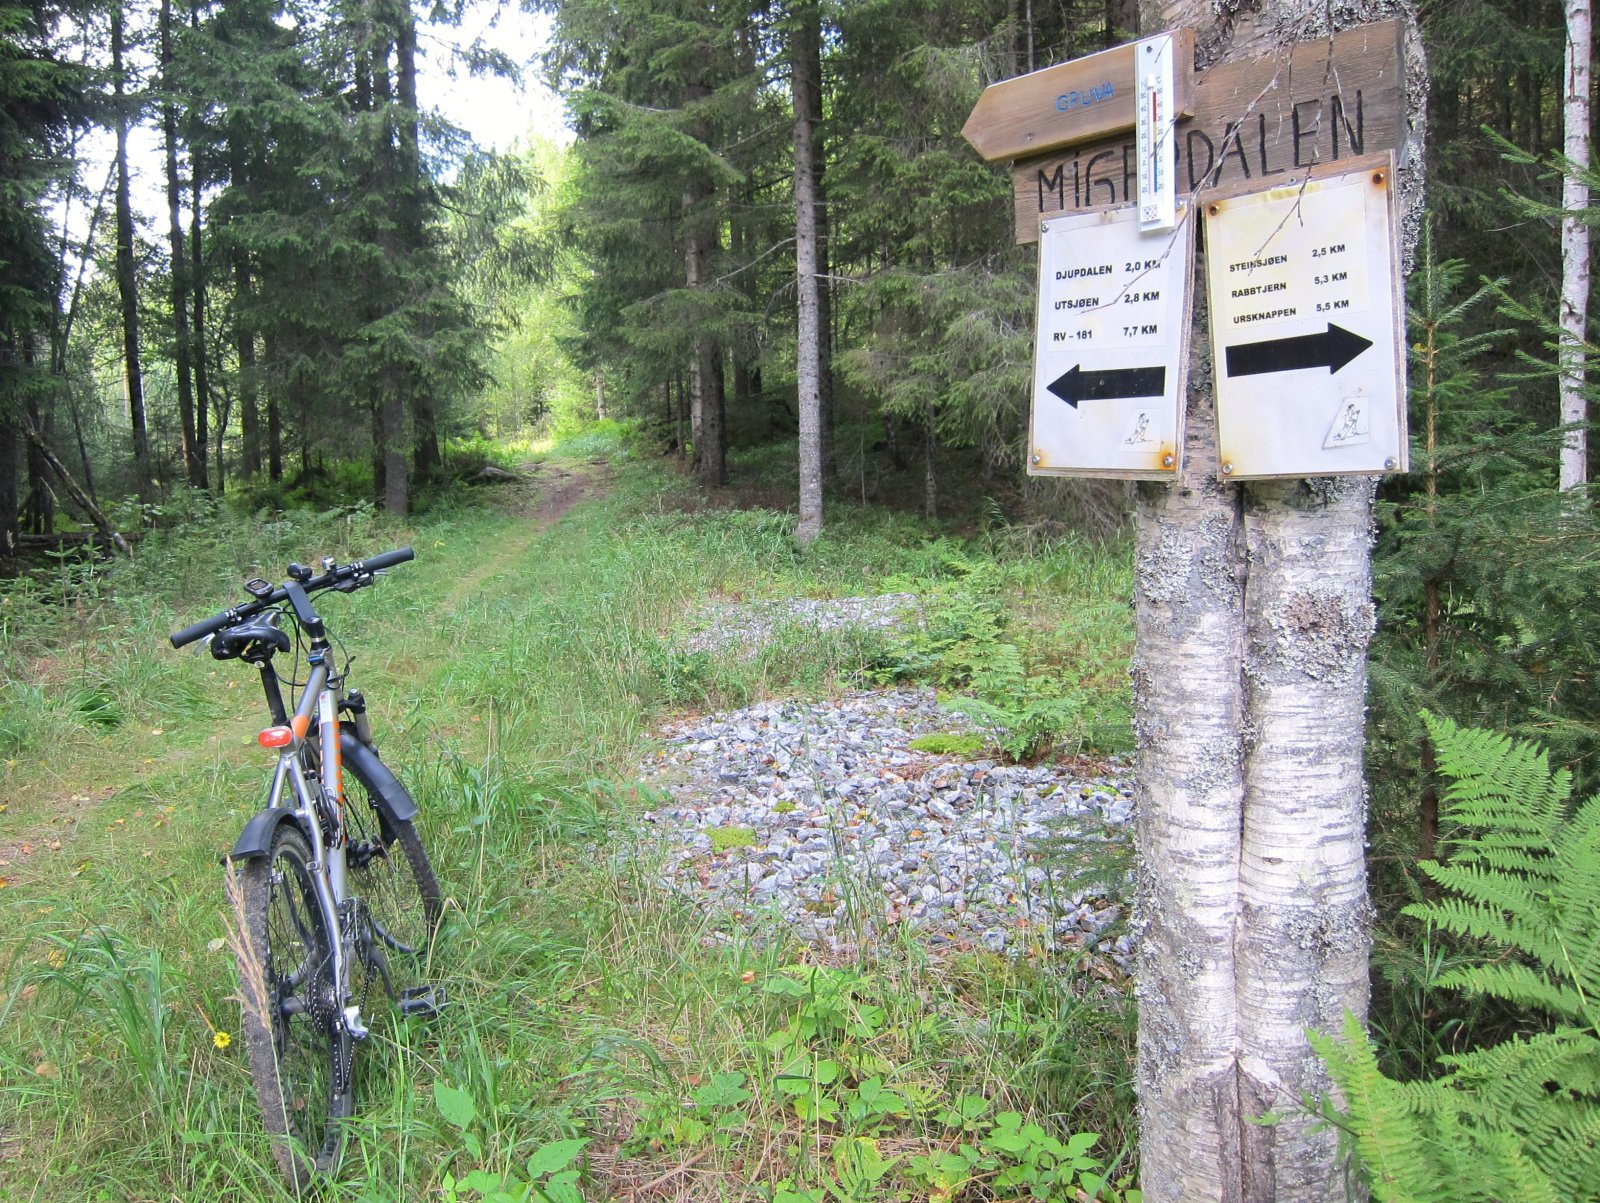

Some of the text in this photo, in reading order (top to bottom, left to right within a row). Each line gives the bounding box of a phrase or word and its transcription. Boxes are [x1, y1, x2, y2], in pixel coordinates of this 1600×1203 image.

[1055, 259, 1161, 280] DJUPDALEN 2,0 KM
[1229, 243, 1346, 273] STEINSJØEN 2,5 KM
[1231, 271, 1348, 298] RABBTJERN 5,3 KM
[1054, 291, 1160, 310] UTSJØEN 2,8 KM
[1233, 299, 1349, 324] URSKNAPPEN 5,5 KM
[1053, 332, 1067, 341] RV
[1076, 330, 1093, 340] 181
[1123, 327, 1139, 337] 7,7
[1141, 324, 1158, 335] KM
